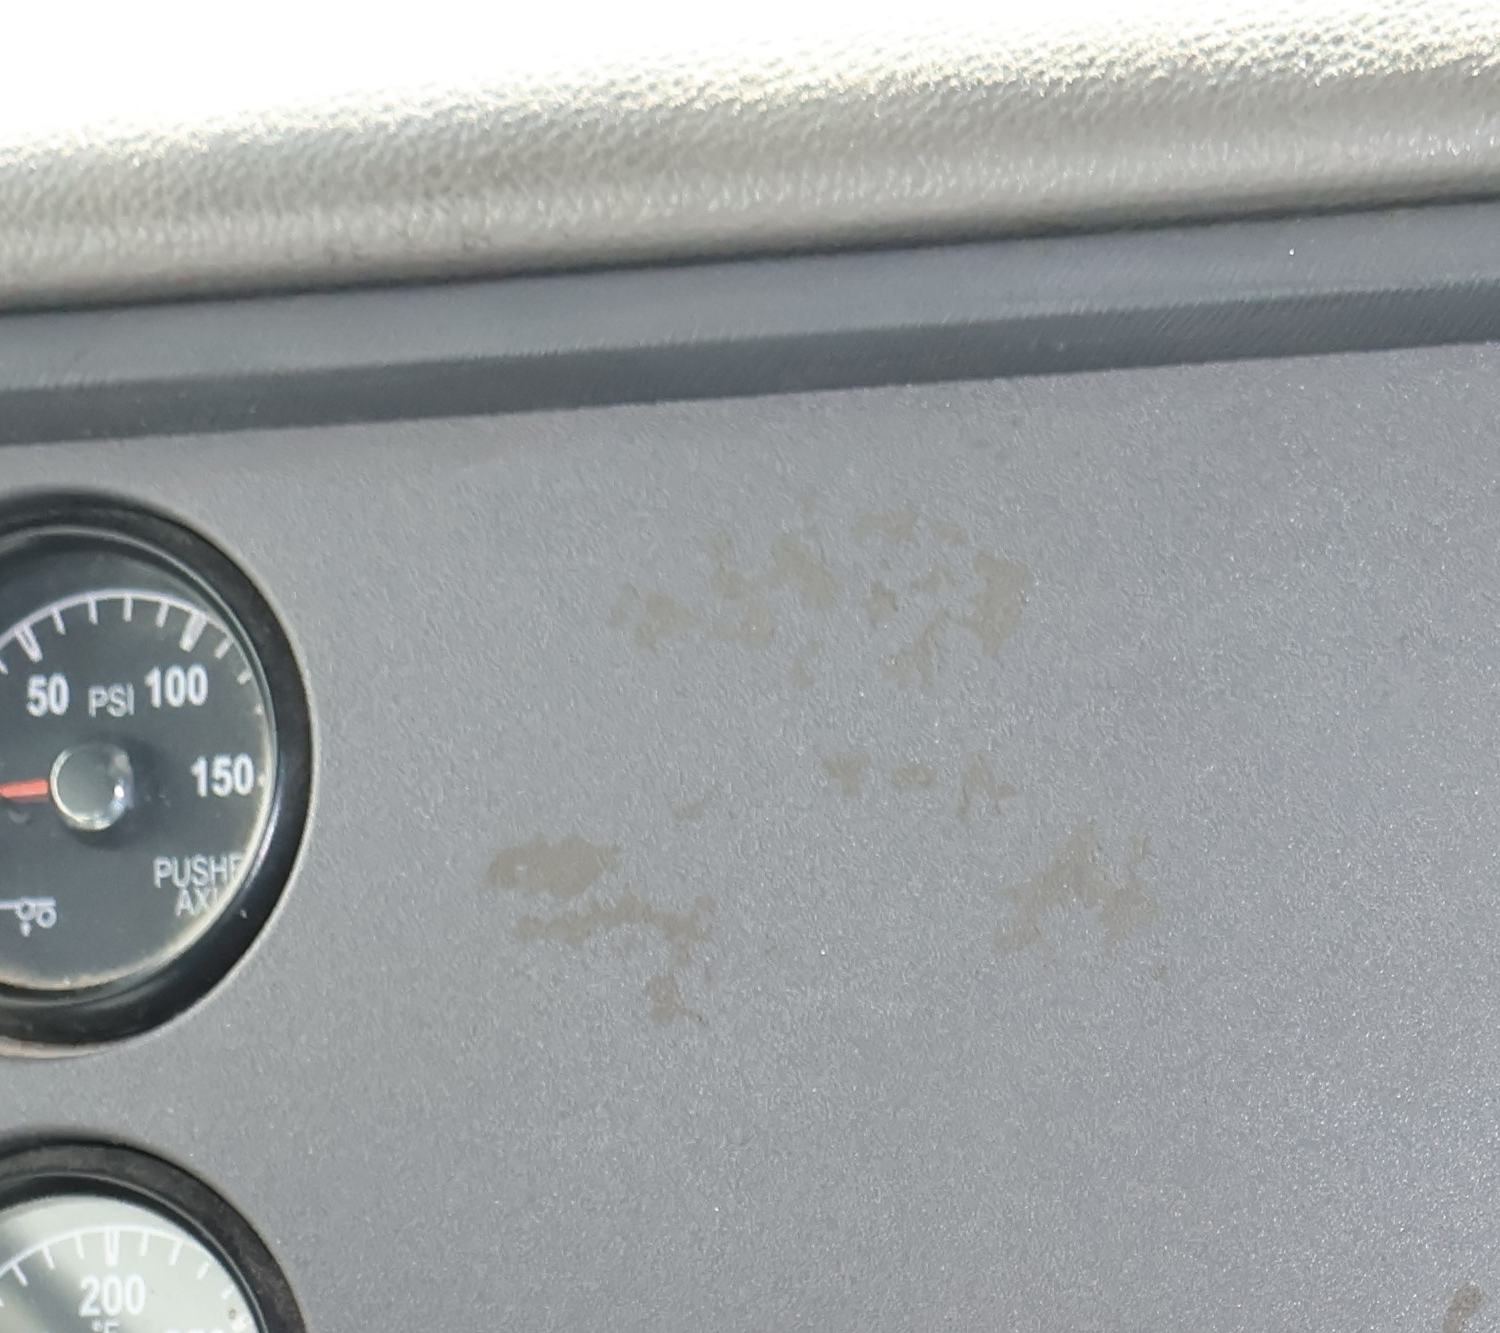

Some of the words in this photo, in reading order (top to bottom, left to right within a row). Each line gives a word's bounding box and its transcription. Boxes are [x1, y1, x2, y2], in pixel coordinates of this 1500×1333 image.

[26, 673, 69, 718] 50
[88, 685, 135, 717] PSI
[144, 665, 208, 707] 100
[191, 753, 254, 796] 150
[79, 1274, 146, 1316] 200
